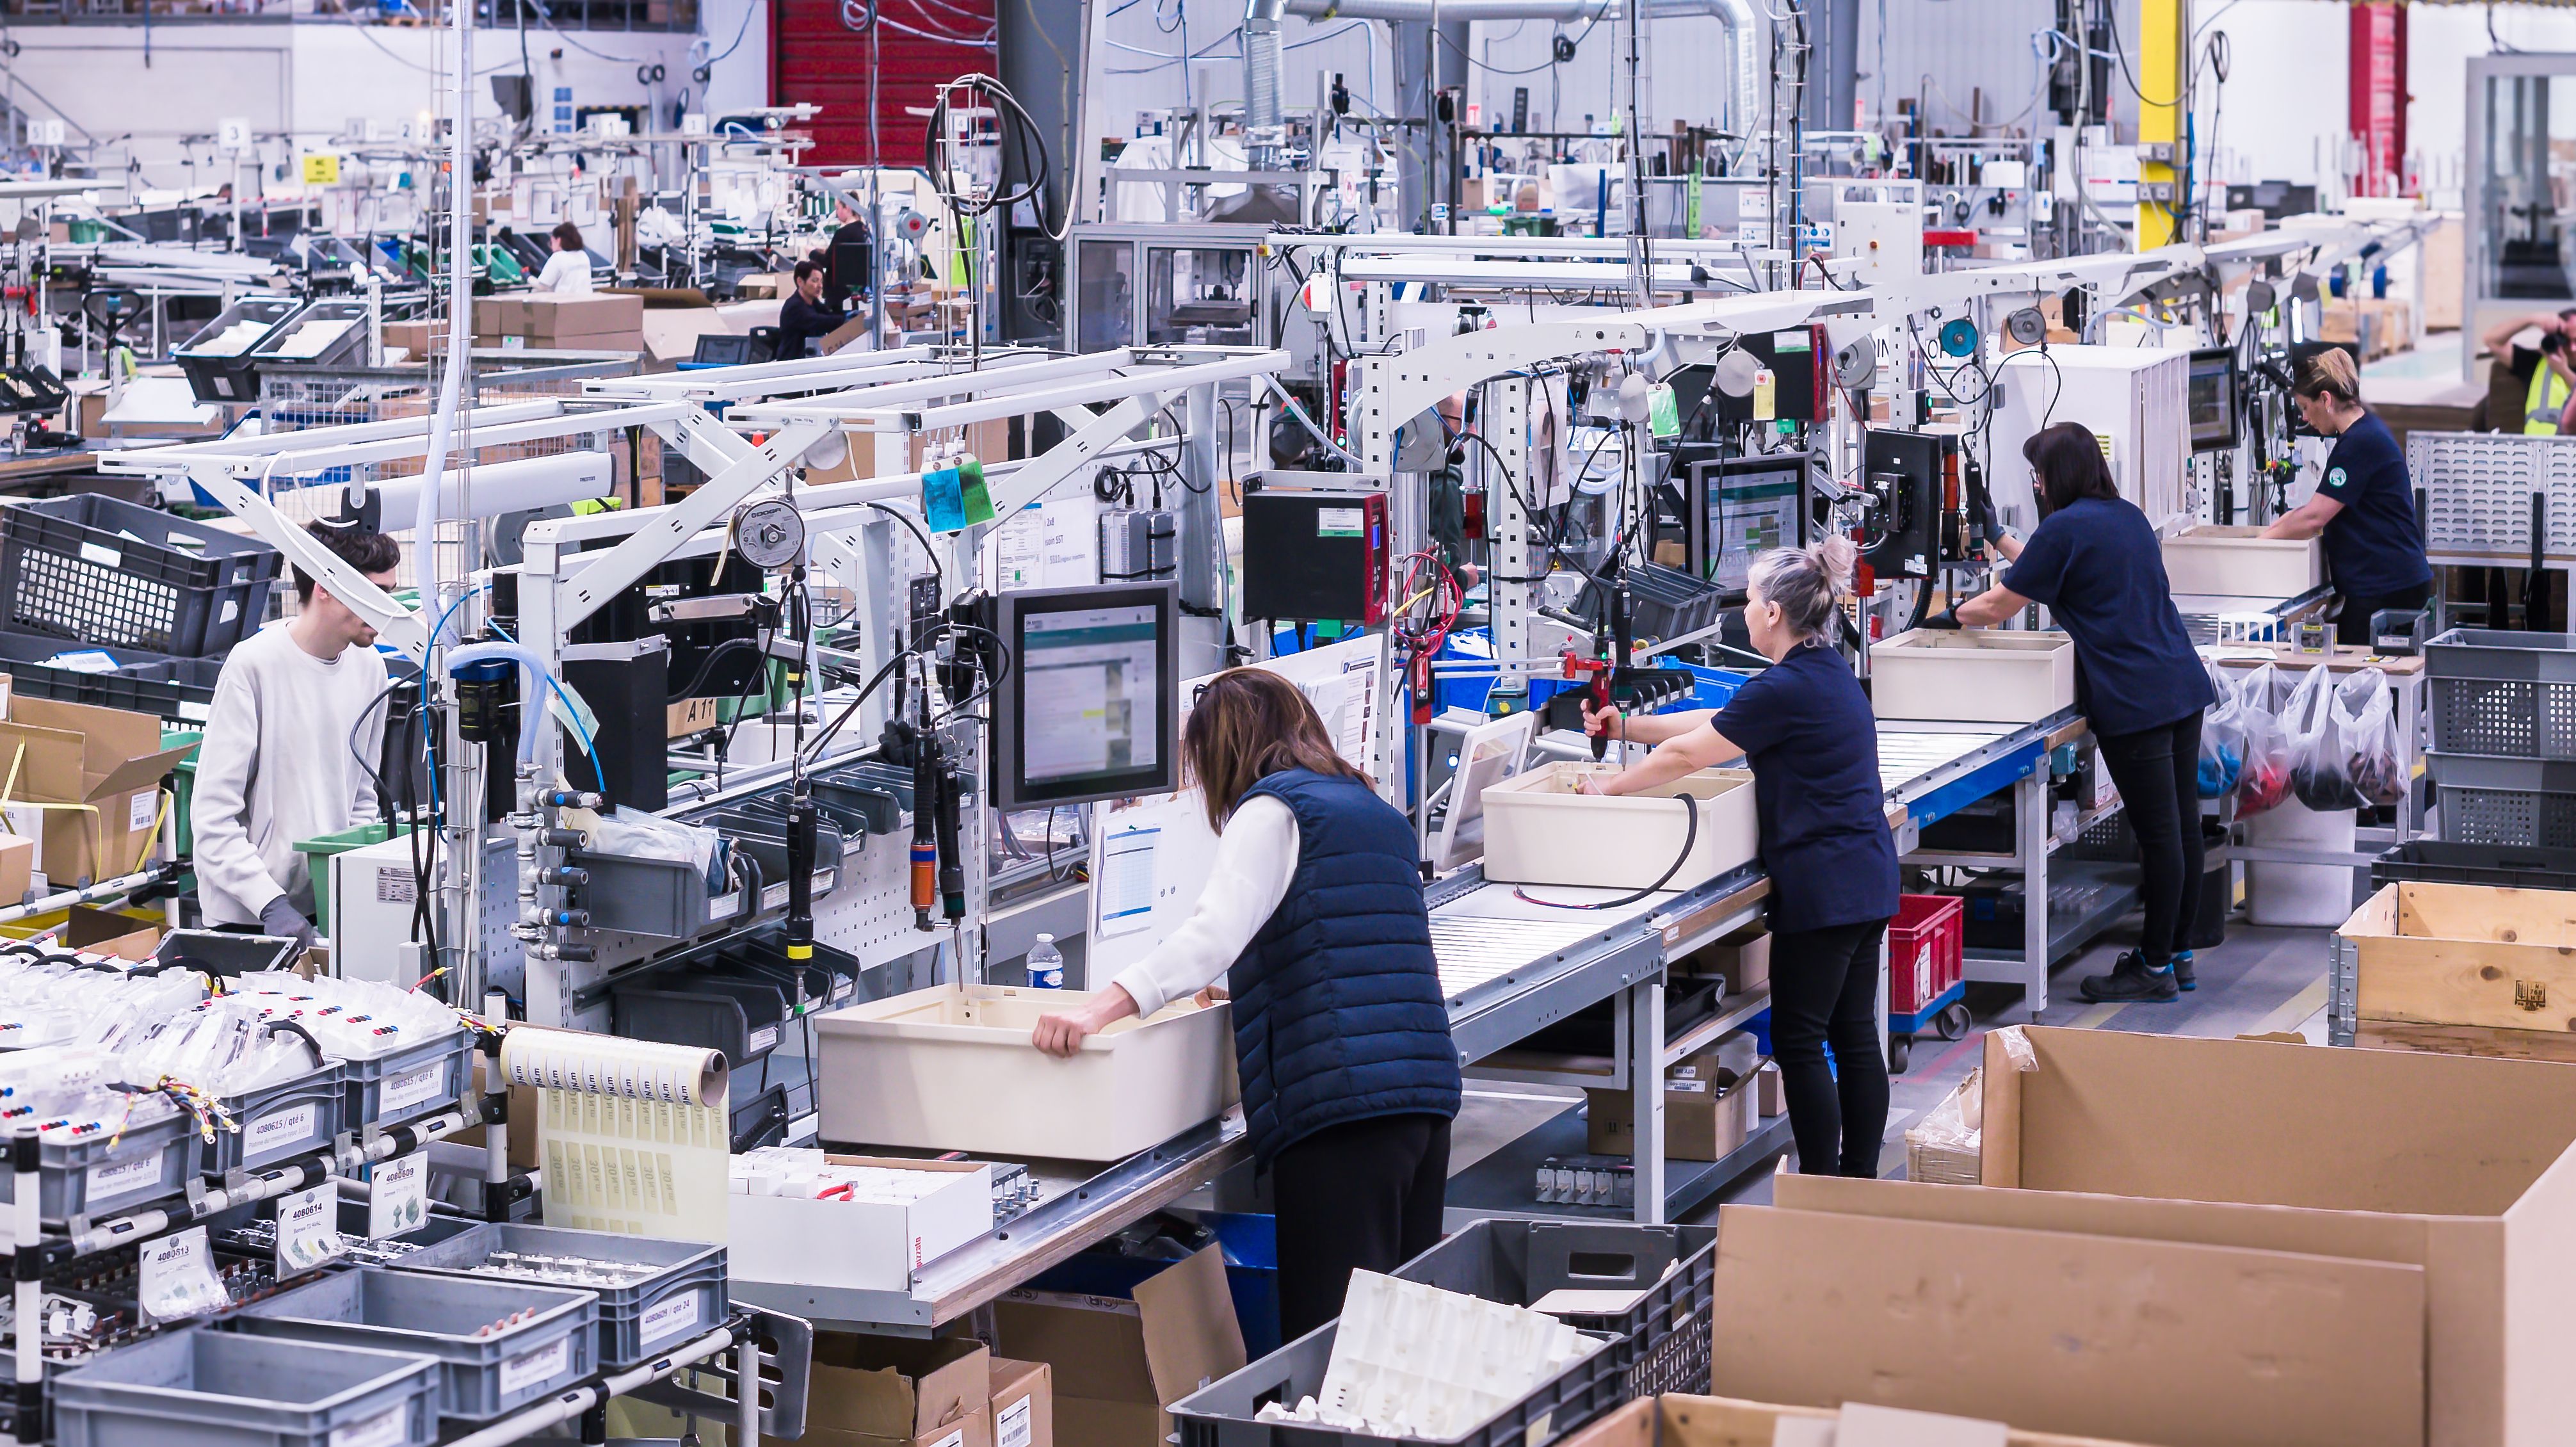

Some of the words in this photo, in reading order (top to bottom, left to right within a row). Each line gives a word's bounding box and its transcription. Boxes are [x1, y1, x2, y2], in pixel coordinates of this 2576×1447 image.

[230, 126, 239, 140] 3
[403, 124, 410, 138] 2
[422, 125, 428, 138] 2
[688, 700, 696, 723] A
[430, 1069, 433, 1079] 6
[256, 1119, 283, 1135] 4080615
[300, 1113, 304, 1122] 6
[293, 1202, 323, 1219] 4080614
